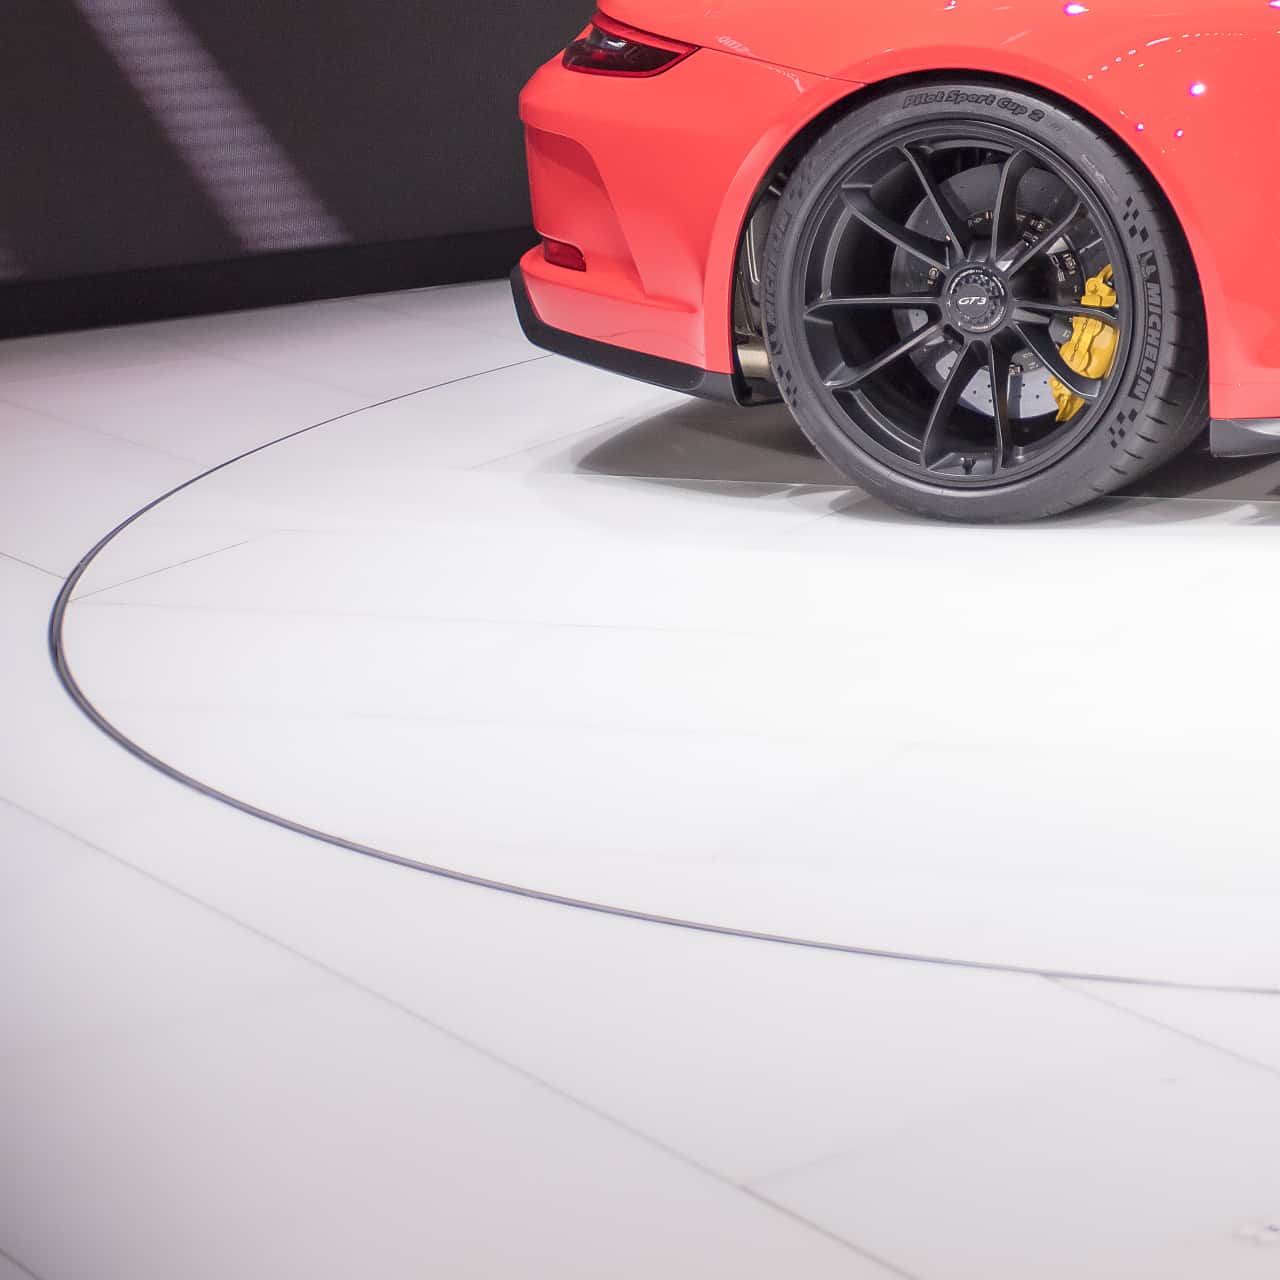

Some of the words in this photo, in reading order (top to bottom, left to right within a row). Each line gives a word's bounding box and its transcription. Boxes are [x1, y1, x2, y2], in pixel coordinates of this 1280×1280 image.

[902, 90, 945, 109] Pilot
[946, 89, 996, 107] Sport
[996, 97, 1029, 116] Cup
[1028, 109, 1046, 122] 2
[958, 296, 987, 306] GT3
[1131, 281, 1163, 401] MICHELIN
